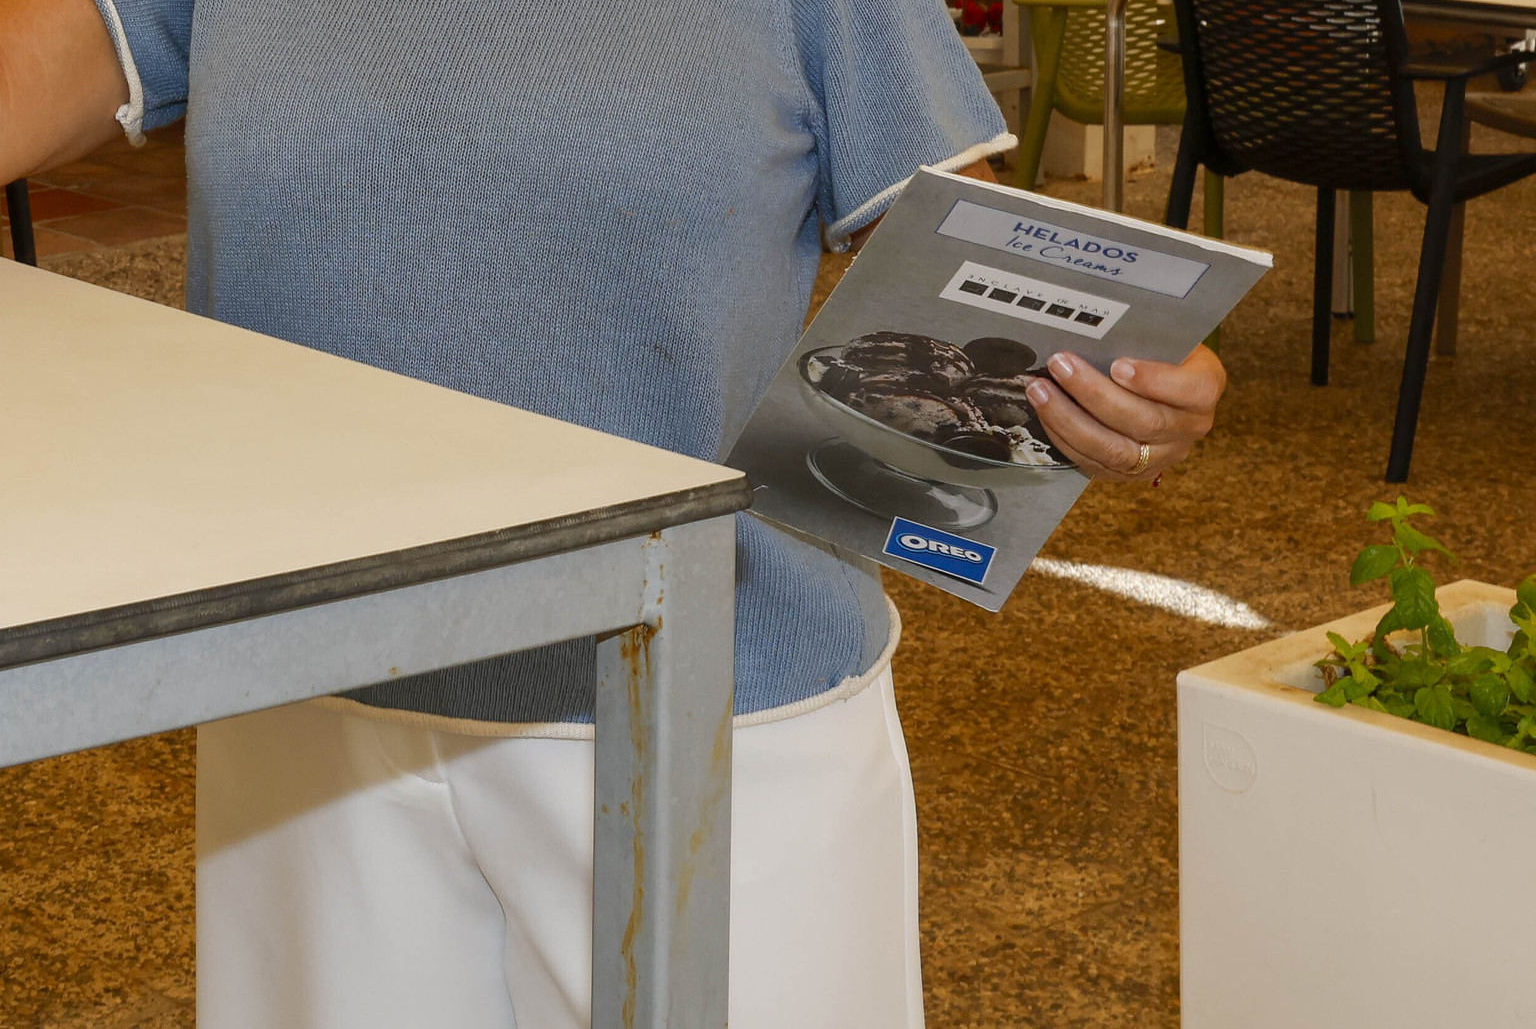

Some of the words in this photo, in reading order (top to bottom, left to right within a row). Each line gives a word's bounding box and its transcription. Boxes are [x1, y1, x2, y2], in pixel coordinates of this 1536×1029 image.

[1005, 235, 1033, 252] Ice
[1039, 245, 1123, 276] Creams
[1013, 222, 1139, 263] HELADOS
[900, 535, 982, 562] OREO
